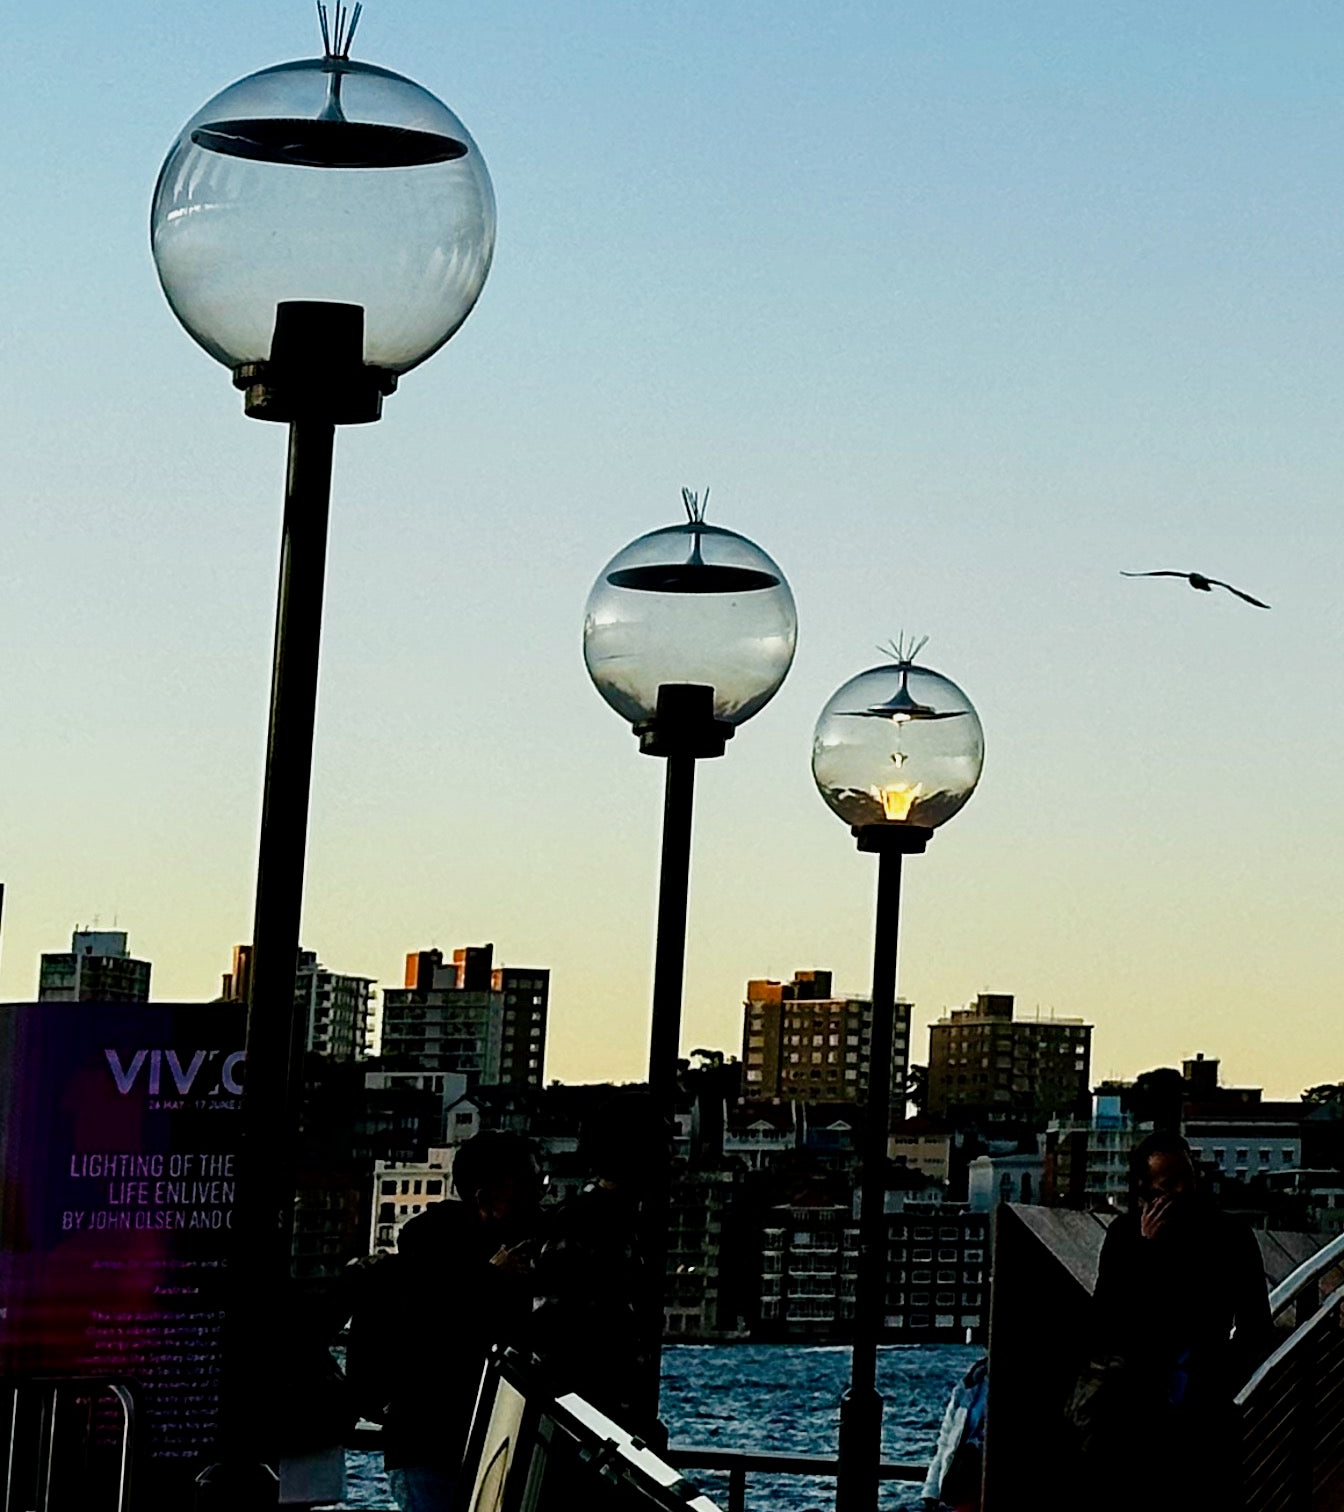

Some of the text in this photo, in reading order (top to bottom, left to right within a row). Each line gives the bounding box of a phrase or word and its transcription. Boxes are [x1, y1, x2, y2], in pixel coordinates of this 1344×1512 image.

[195, 1099, 206, 1110] 17
[70, 1153, 236, 1178] LIGHTING OF THE
[109, 1181, 149, 1205] LIFE
[62, 1210, 85, 1230] BY
[88, 1210, 131, 1230] JOHN
[135, 1210, 186, 1230] OLSEN
[190, 1209, 222, 1230] AND
